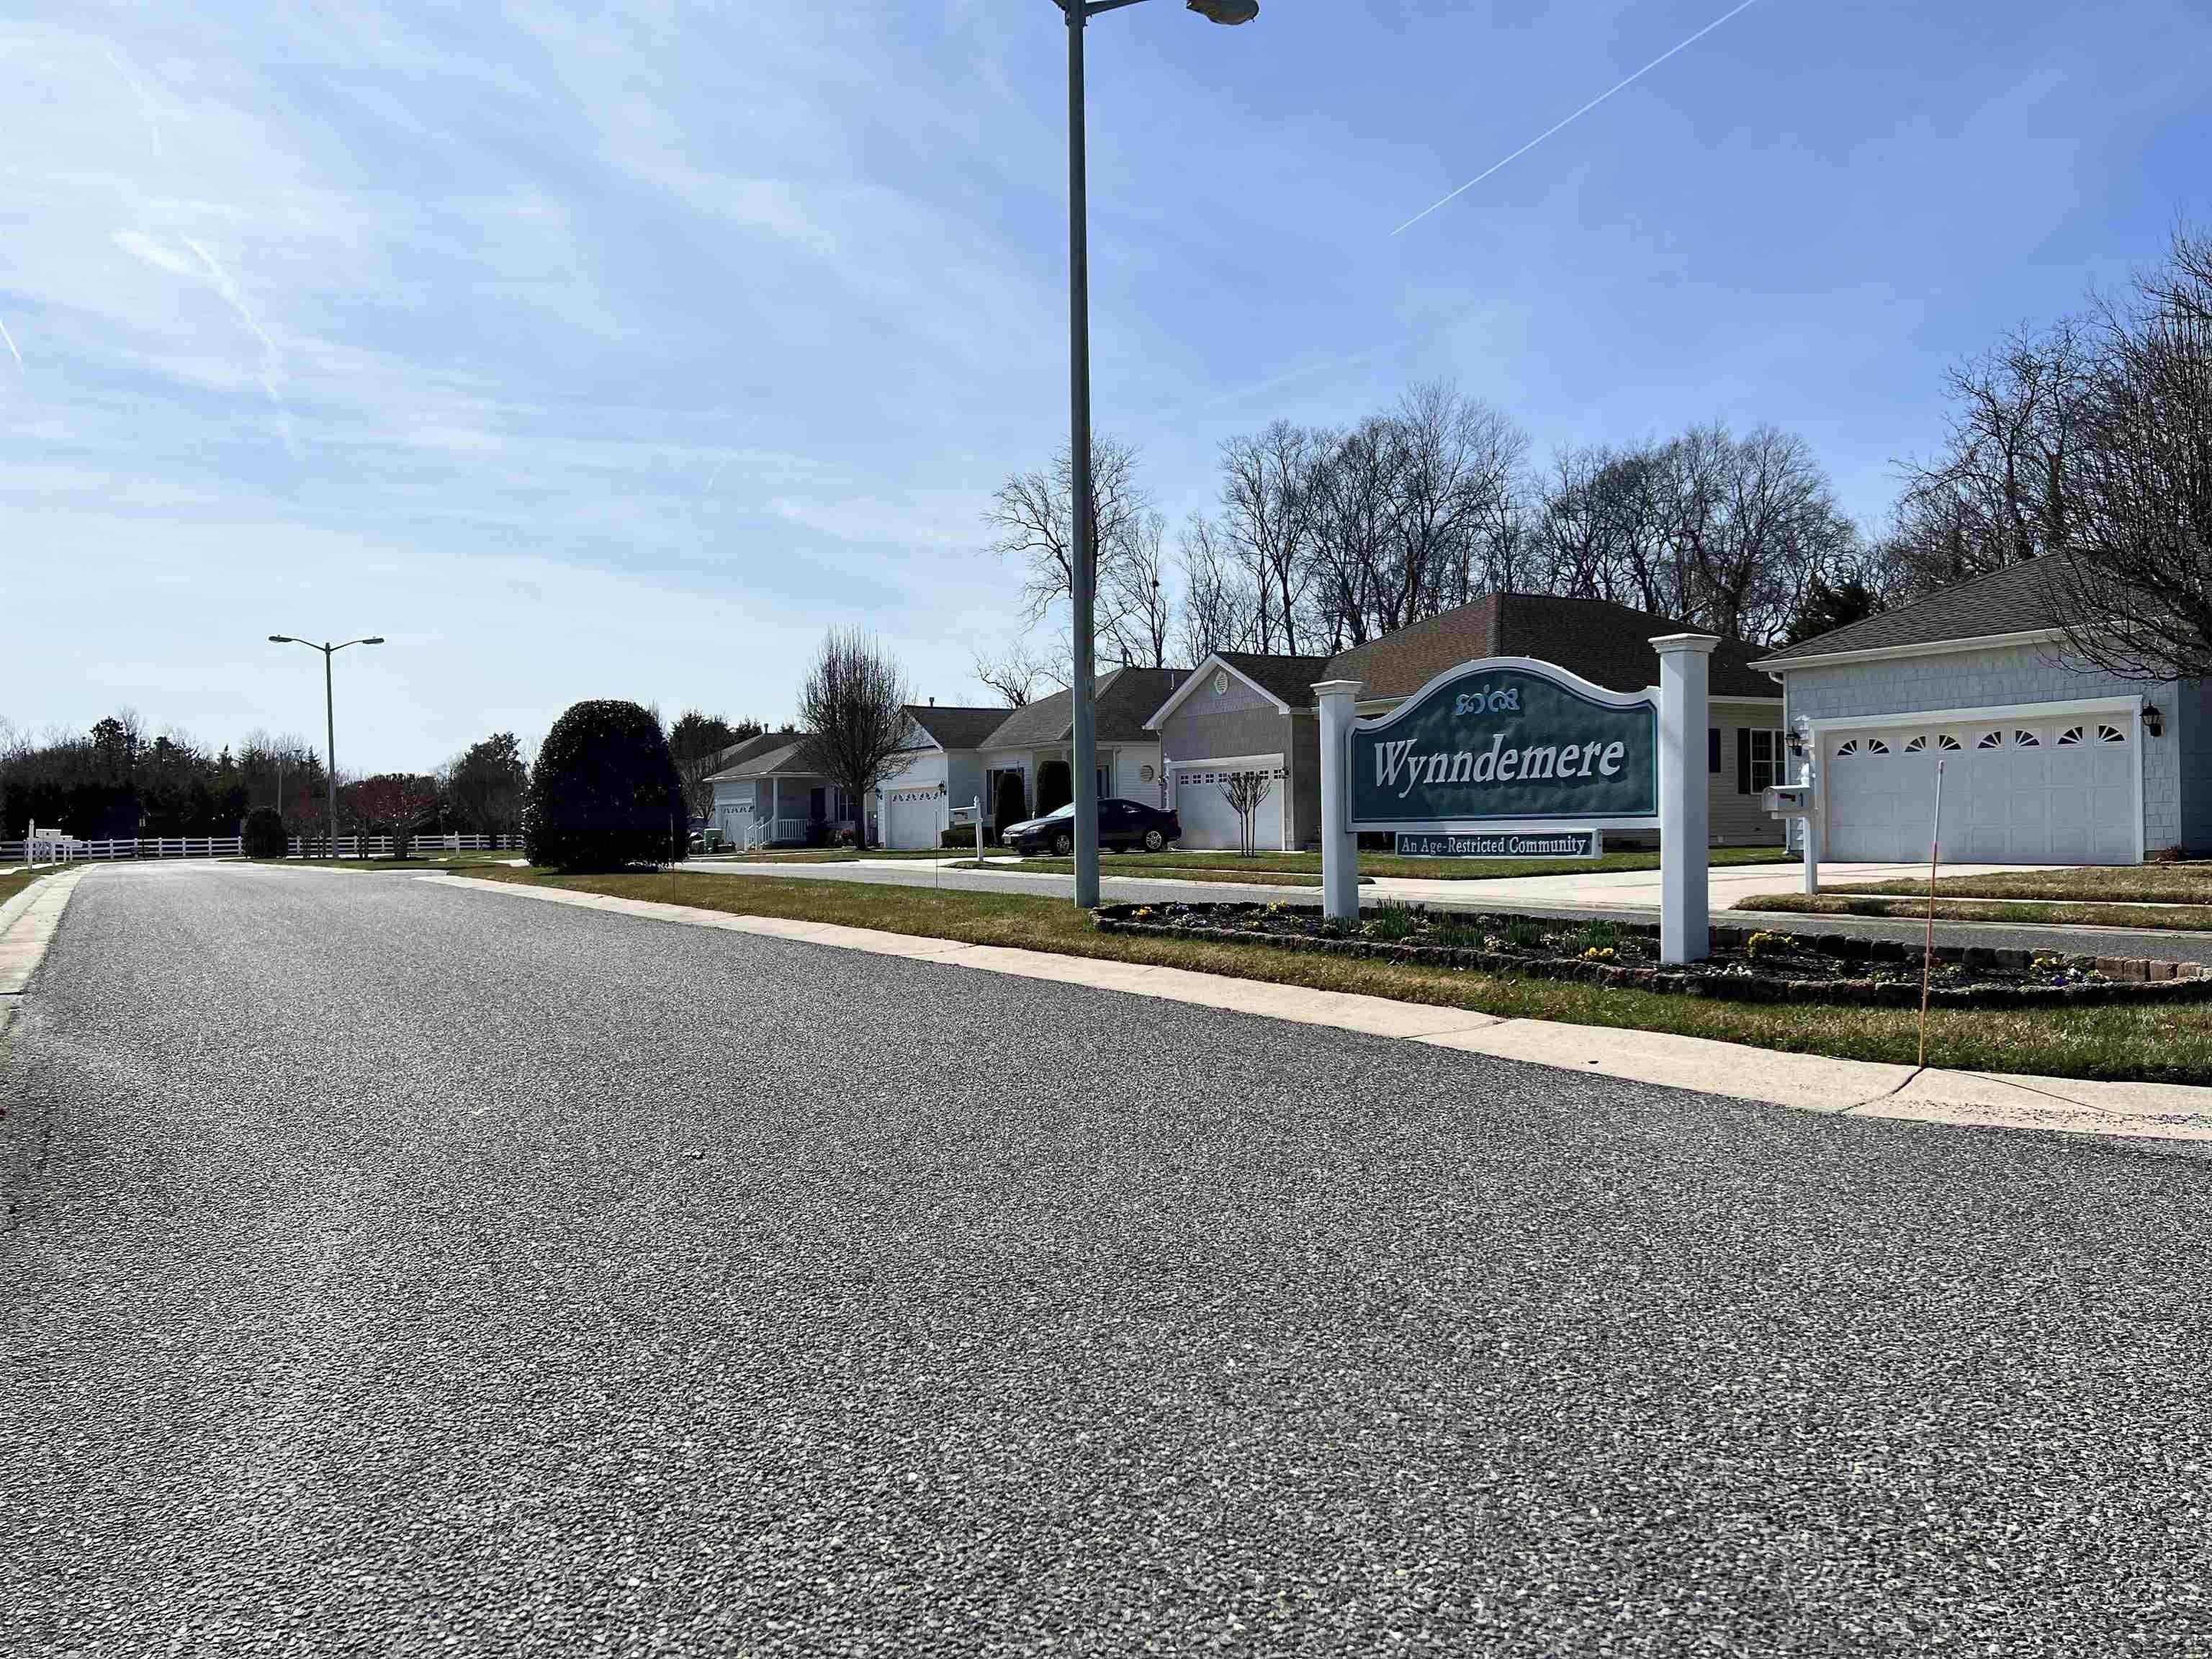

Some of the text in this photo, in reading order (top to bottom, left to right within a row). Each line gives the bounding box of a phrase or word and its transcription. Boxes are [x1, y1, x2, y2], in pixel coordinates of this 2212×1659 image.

[1374, 733, 1625, 799] Wynndemere
[1401, 835, 1586, 855] An Age-Restricted Community
